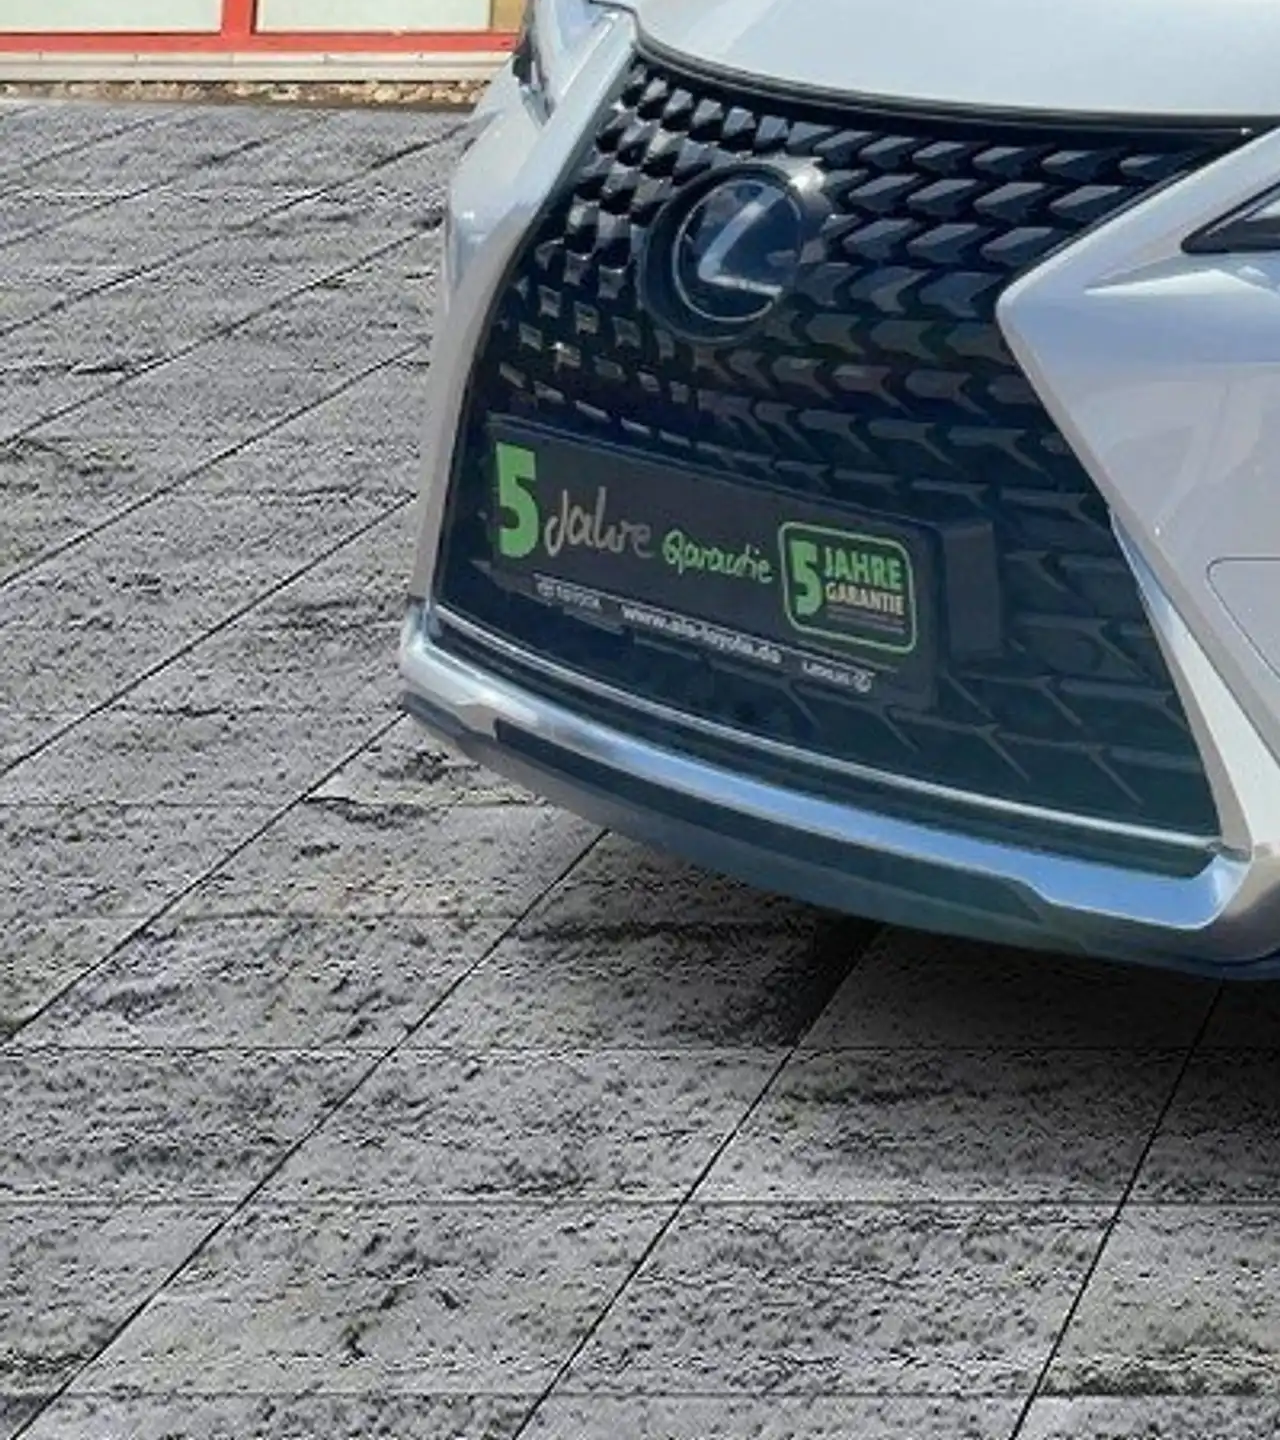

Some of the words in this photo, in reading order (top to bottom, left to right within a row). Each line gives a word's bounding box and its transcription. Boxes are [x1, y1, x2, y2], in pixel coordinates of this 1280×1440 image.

[495, 442, 540, 558] 5
[544, 487, 655, 558] Jahre
[790, 540, 822, 615] 5
[824, 546, 902, 591] JAHRE
[825, 582, 904, 615] GARANTIE
